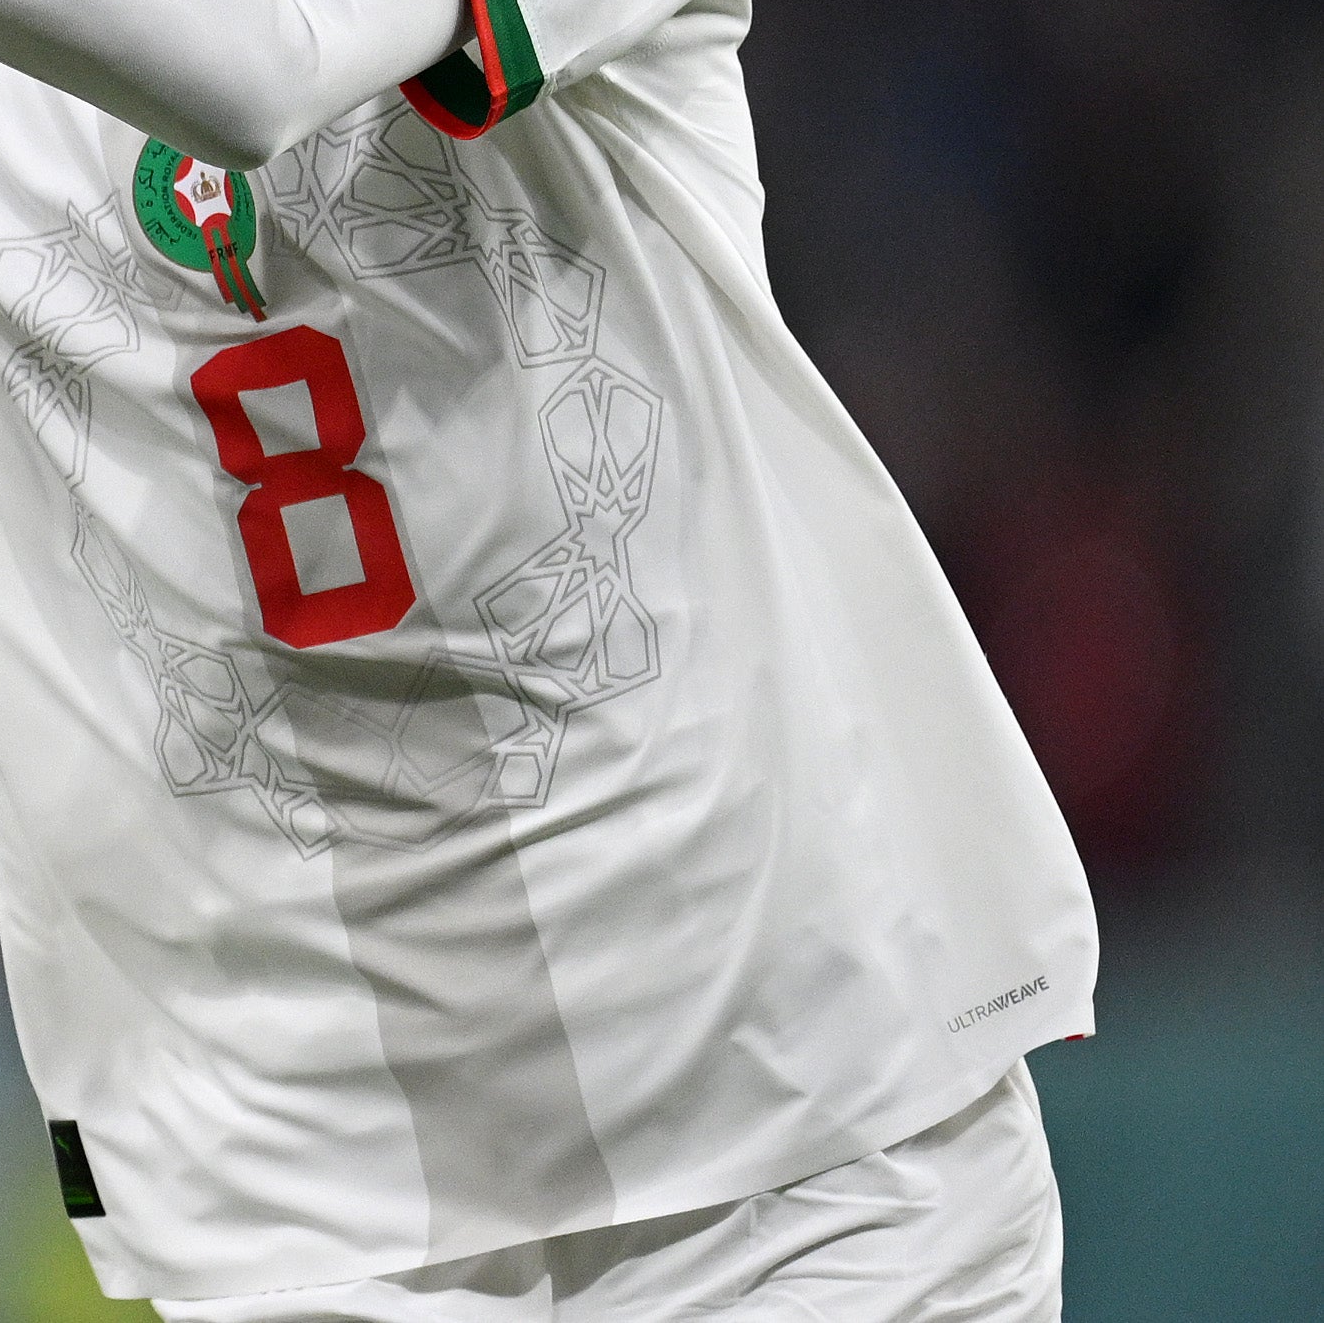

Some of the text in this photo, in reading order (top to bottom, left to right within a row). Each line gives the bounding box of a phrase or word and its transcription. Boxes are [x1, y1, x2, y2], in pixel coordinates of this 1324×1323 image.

[209, 241, 238, 264] FRMF
[190, 324, 417, 650] 8
[947, 975, 1051, 1034] ULTRAWEAVE
